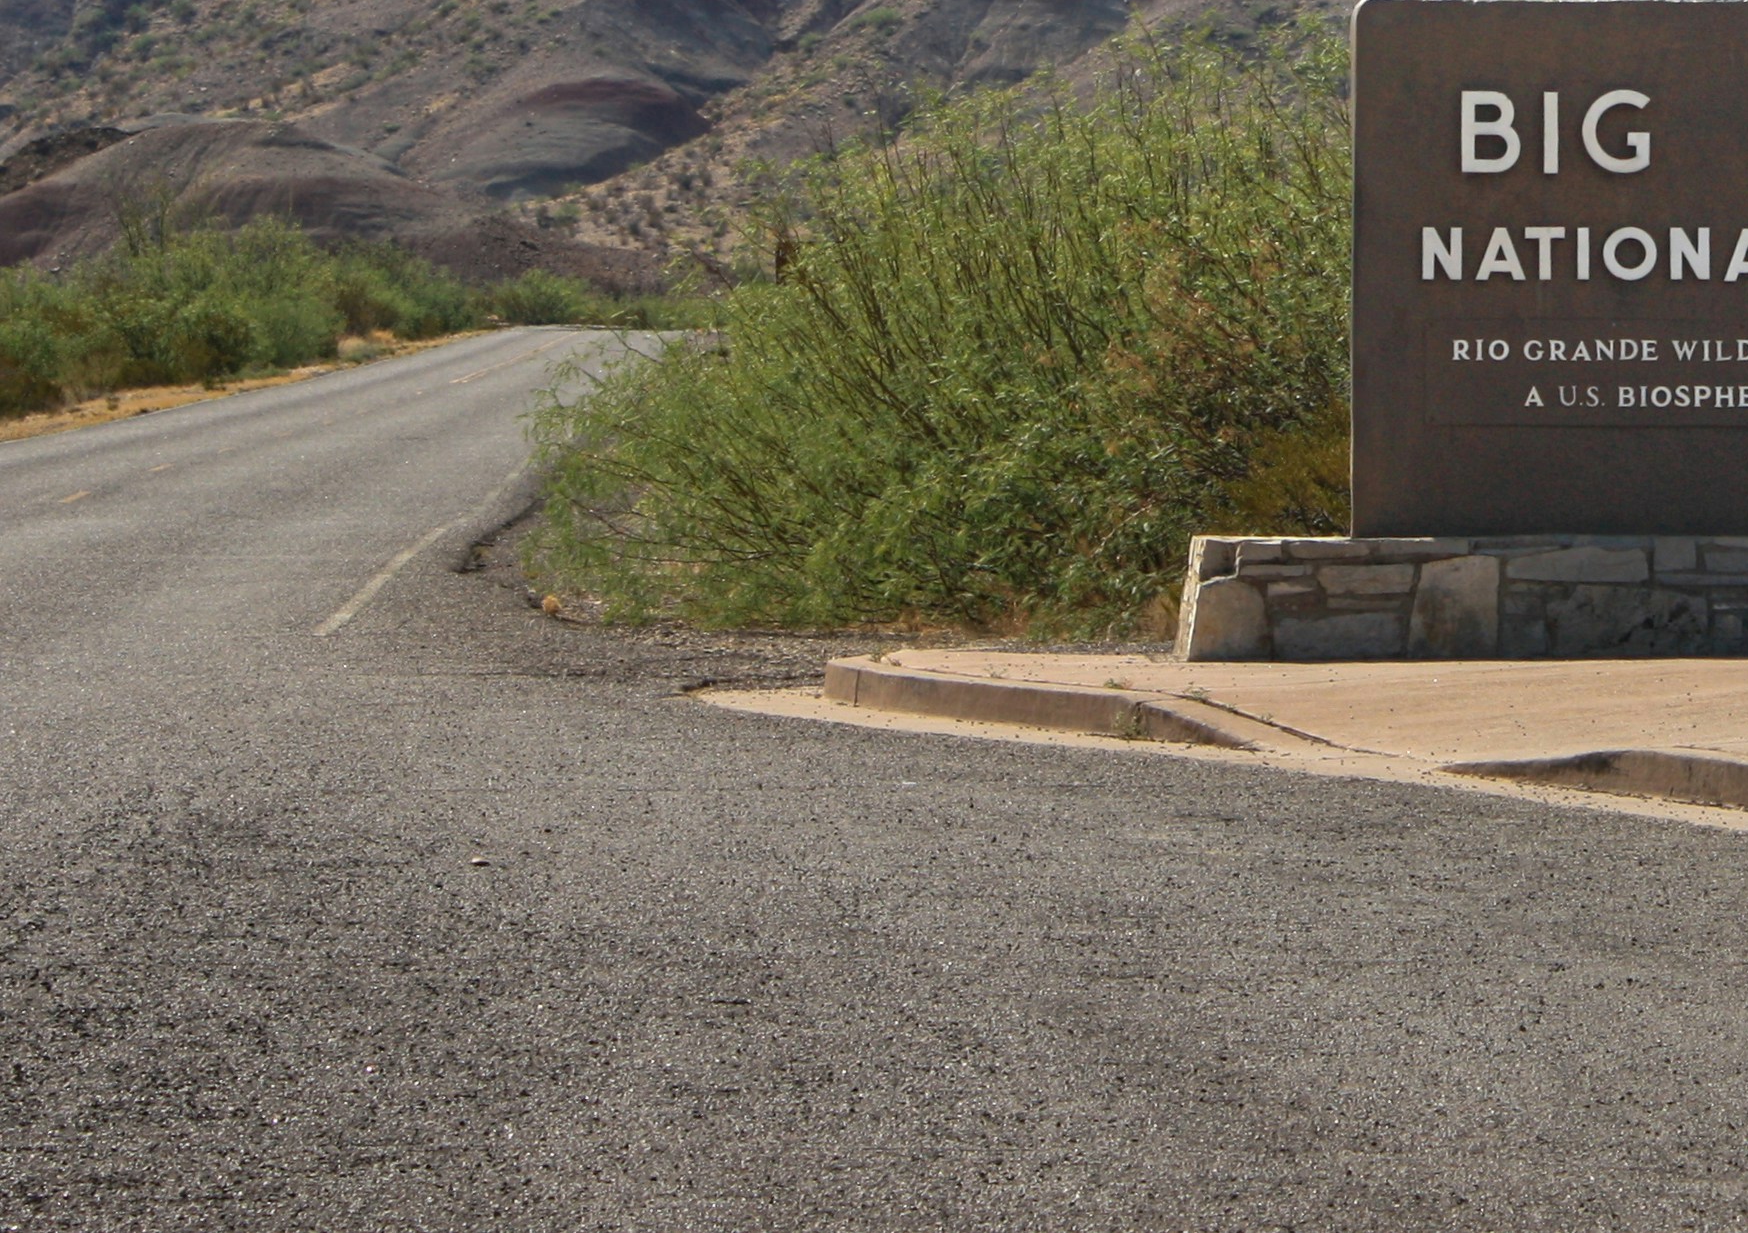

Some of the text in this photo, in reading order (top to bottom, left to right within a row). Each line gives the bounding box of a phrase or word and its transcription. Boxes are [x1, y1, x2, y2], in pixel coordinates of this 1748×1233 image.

[1460, 89, 1651, 174] BIG
[1452, 339, 1510, 361] RIO
[1523, 339, 1659, 361] GRANDE
[1524, 385, 1544, 407] A
[1558, 385, 1605, 407] U.S.
